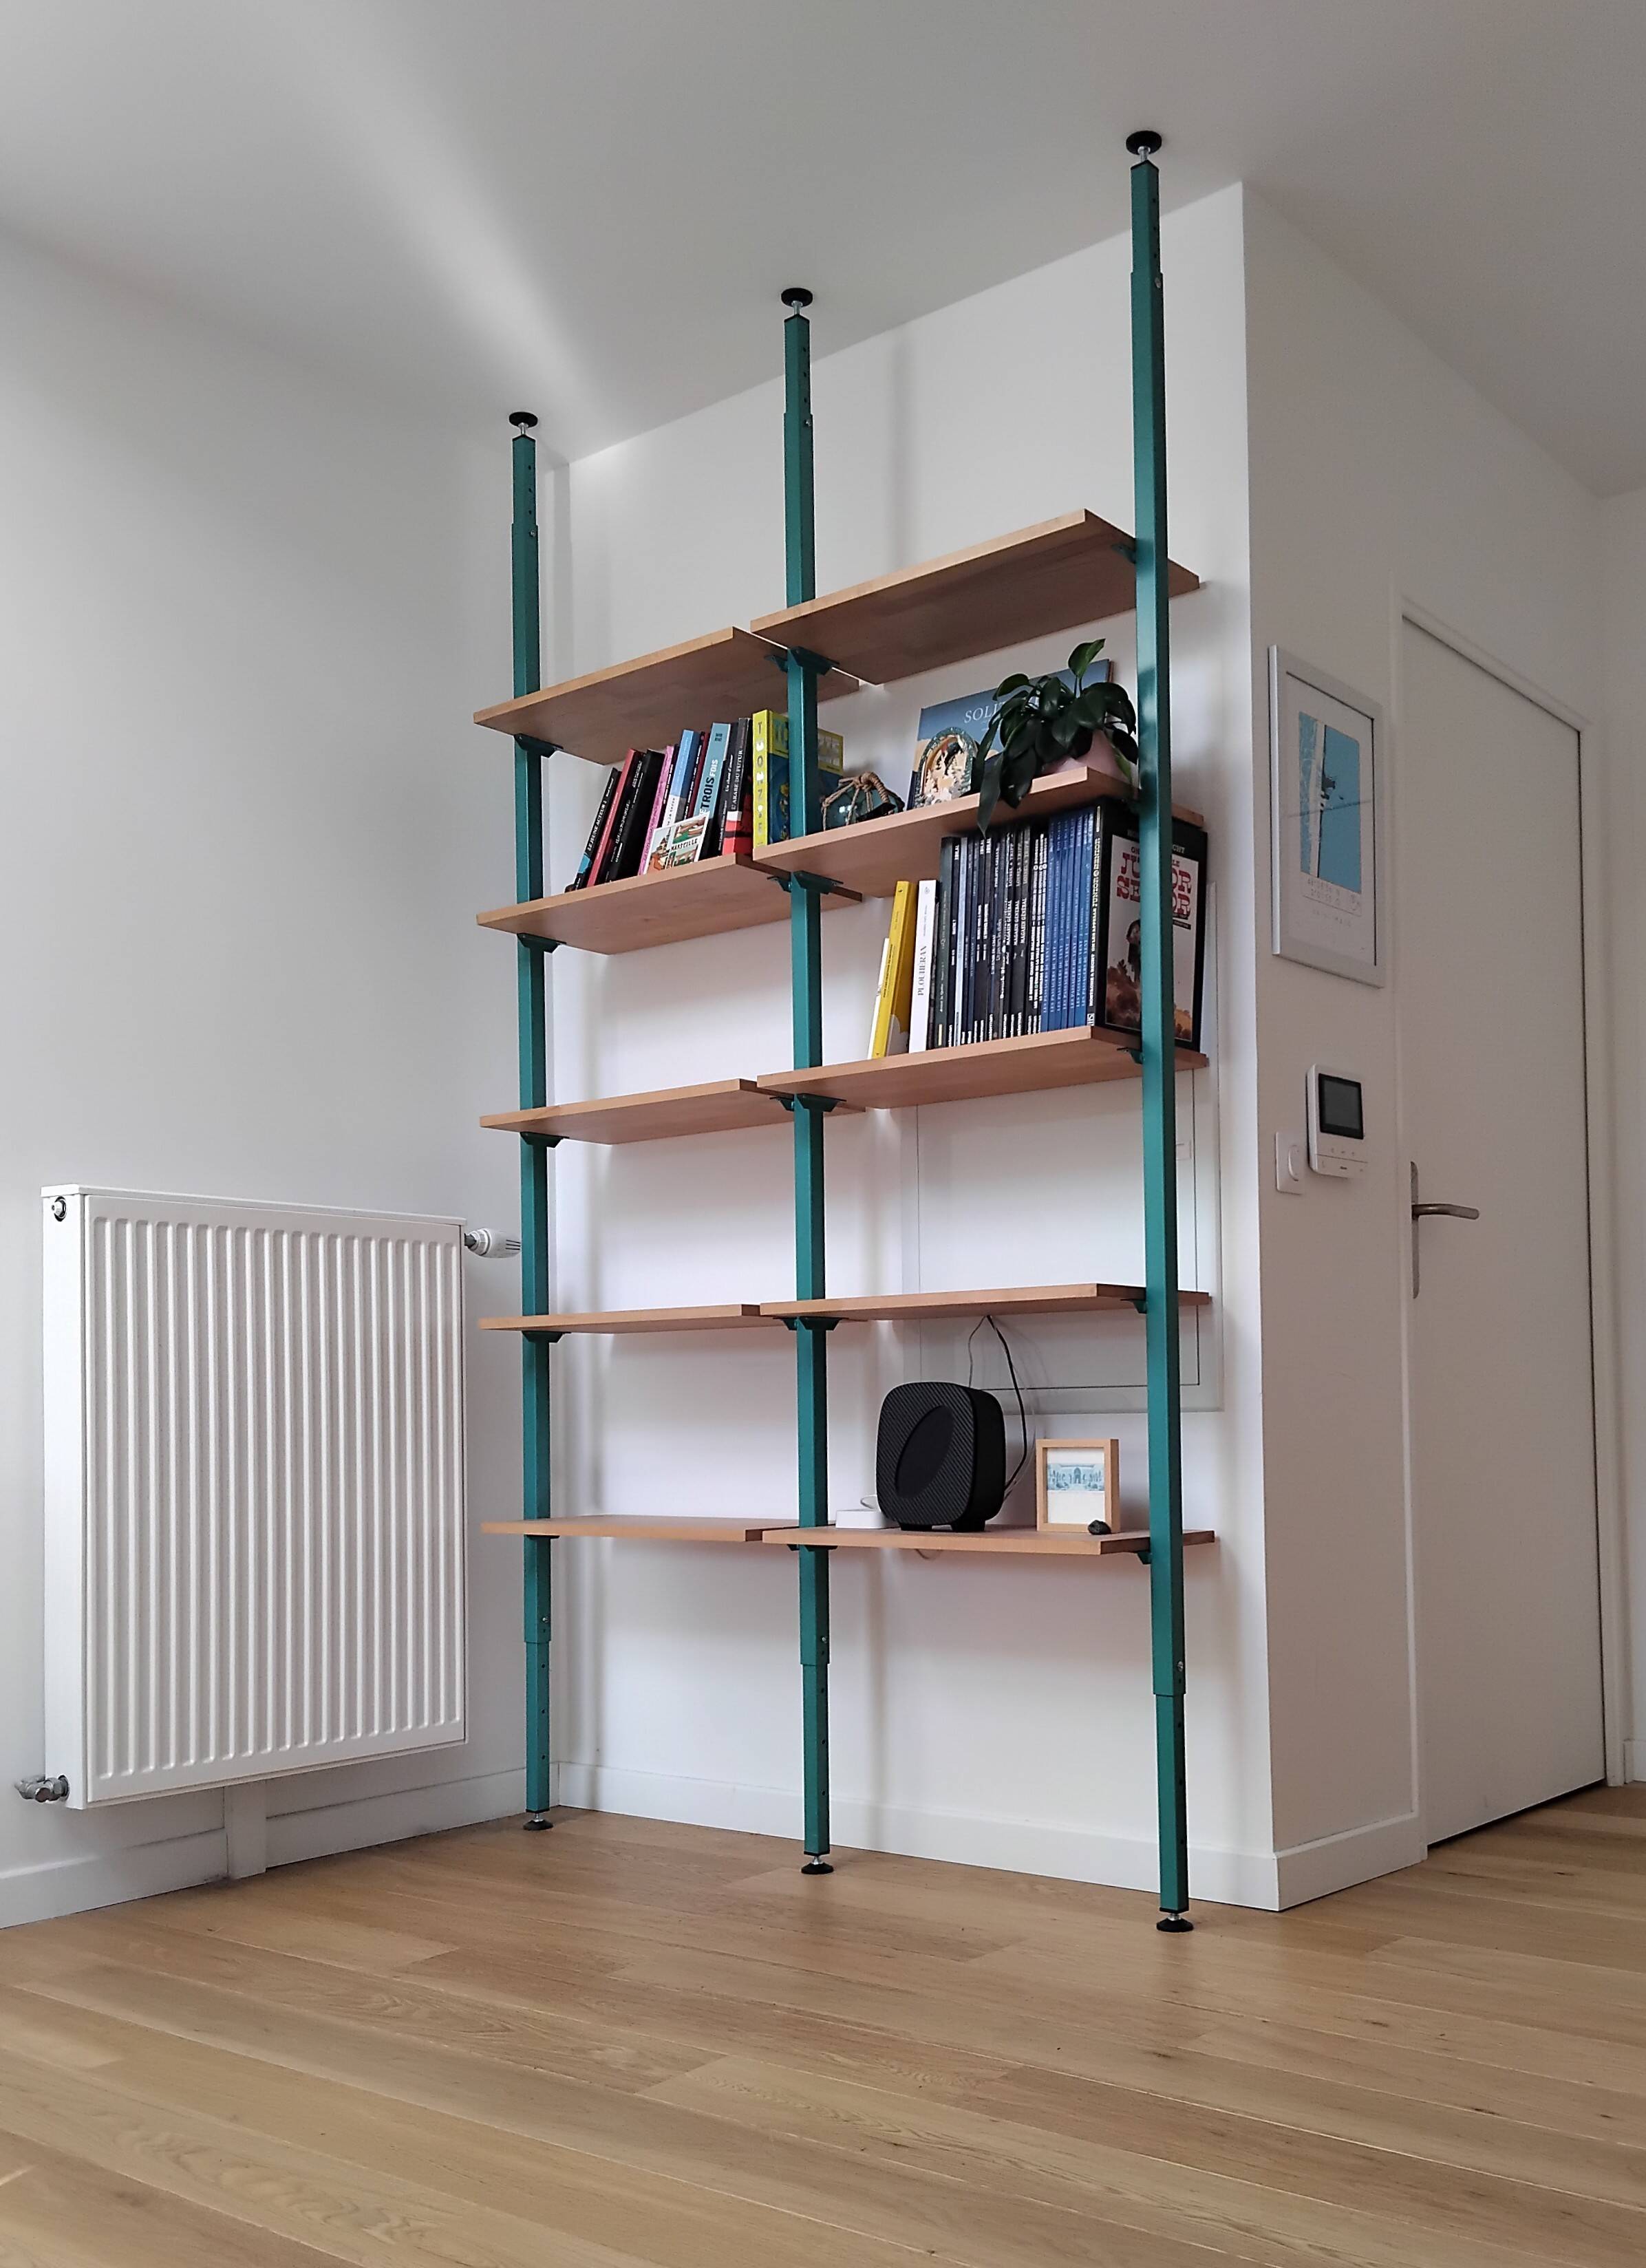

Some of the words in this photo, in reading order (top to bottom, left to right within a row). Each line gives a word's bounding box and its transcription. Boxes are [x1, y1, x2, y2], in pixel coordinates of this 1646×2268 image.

[964, 700, 1005, 724] SOLI
[735, 749, 743, 771] FUTUR
[701, 777, 714, 811] TROIS
[710, 759, 718, 778] FOIS
[734, 773, 740, 782] DU
[595, 804, 606, 826] ACTEUR
[588, 824, 599, 844] JEUNE
[586, 842, 593, 851] LE
[670, 838, 698, 852] MARSEILLE
